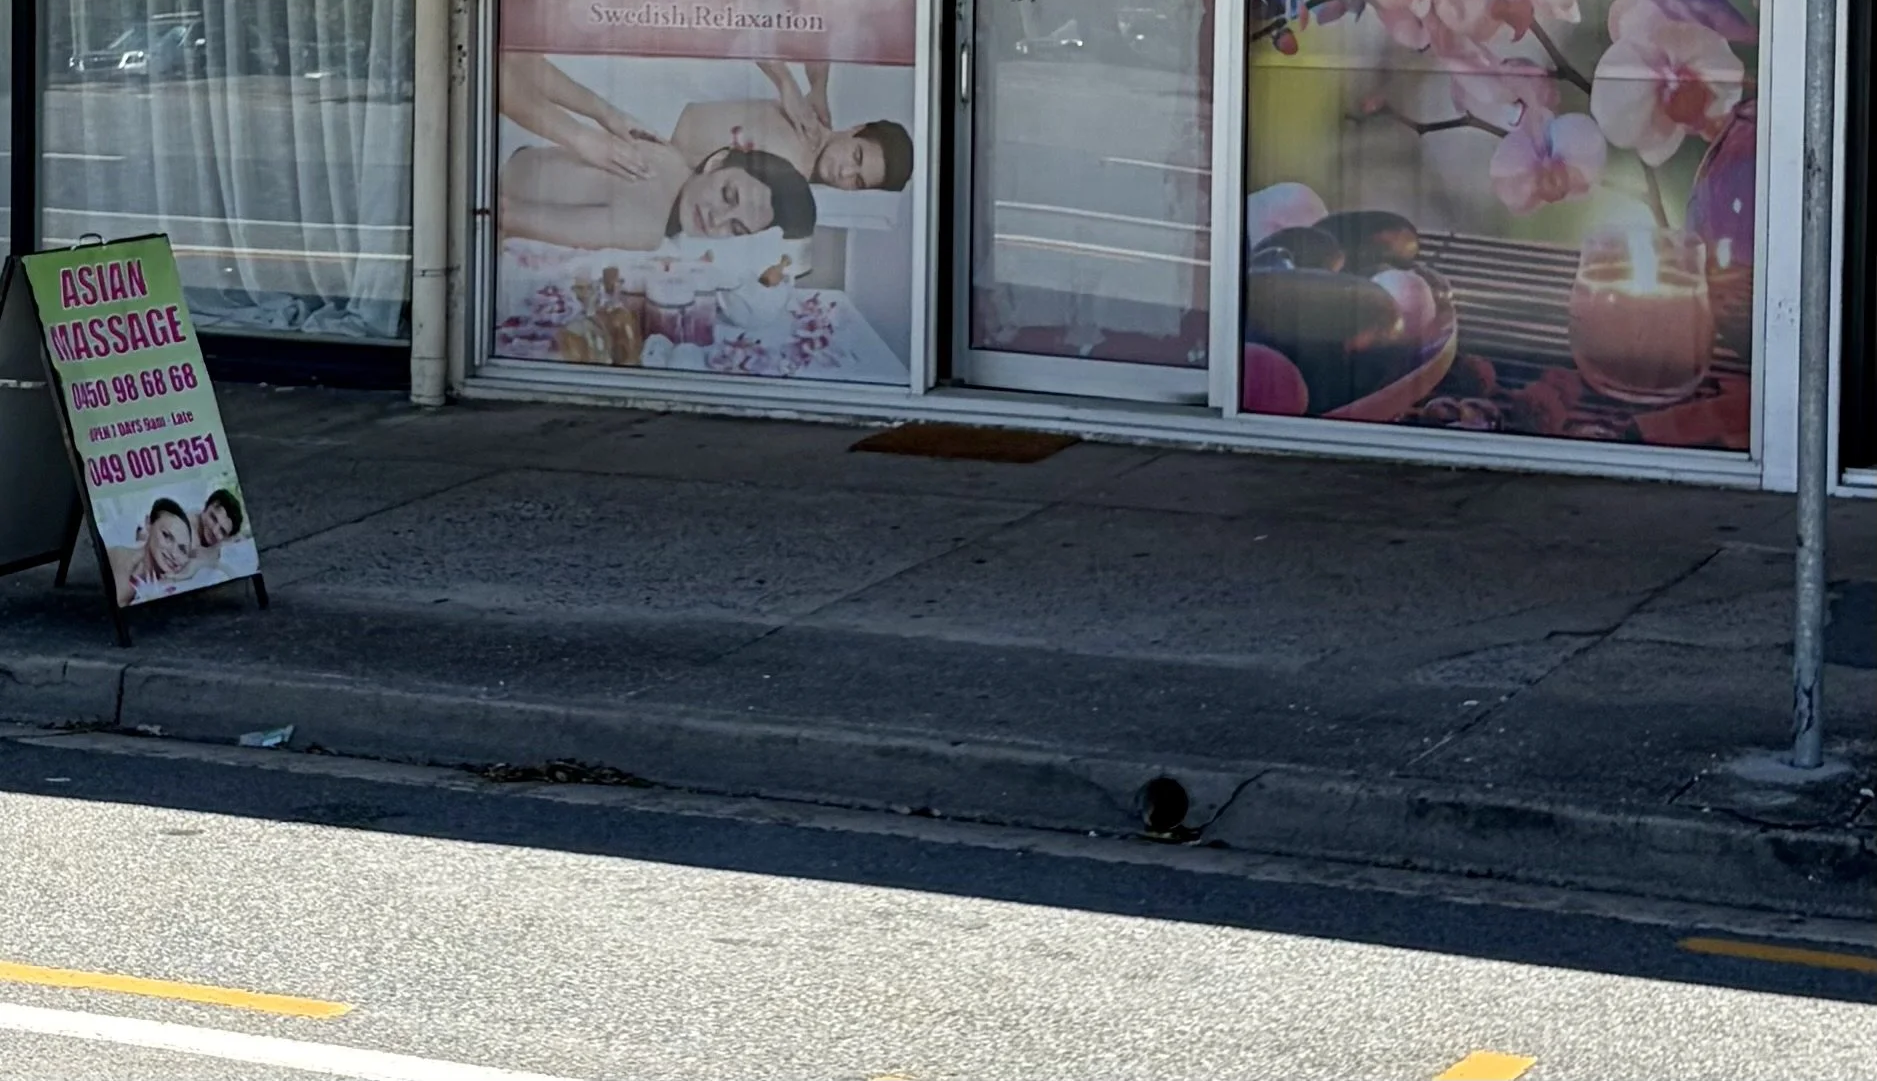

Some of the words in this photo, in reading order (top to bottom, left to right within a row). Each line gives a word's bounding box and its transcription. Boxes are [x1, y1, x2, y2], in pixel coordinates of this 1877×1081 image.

[590, 2, 685, 28] Swedish
[693, 6, 824, 32] Relaxation
[60, 258, 148, 309] ASIAN
[49, 304, 187, 361] MASSAGE
[71, 379, 111, 410] 0450
[112, 373, 139, 403] 98
[140, 368, 168, 398] 68
[169, 362, 198, 392] 68
[117, 419, 143, 437] DAYS
[170, 411, 194, 426] Late
[87, 453, 127, 487] 049
[127, 444, 165, 480] 007
[165, 433, 220, 470] 5351
